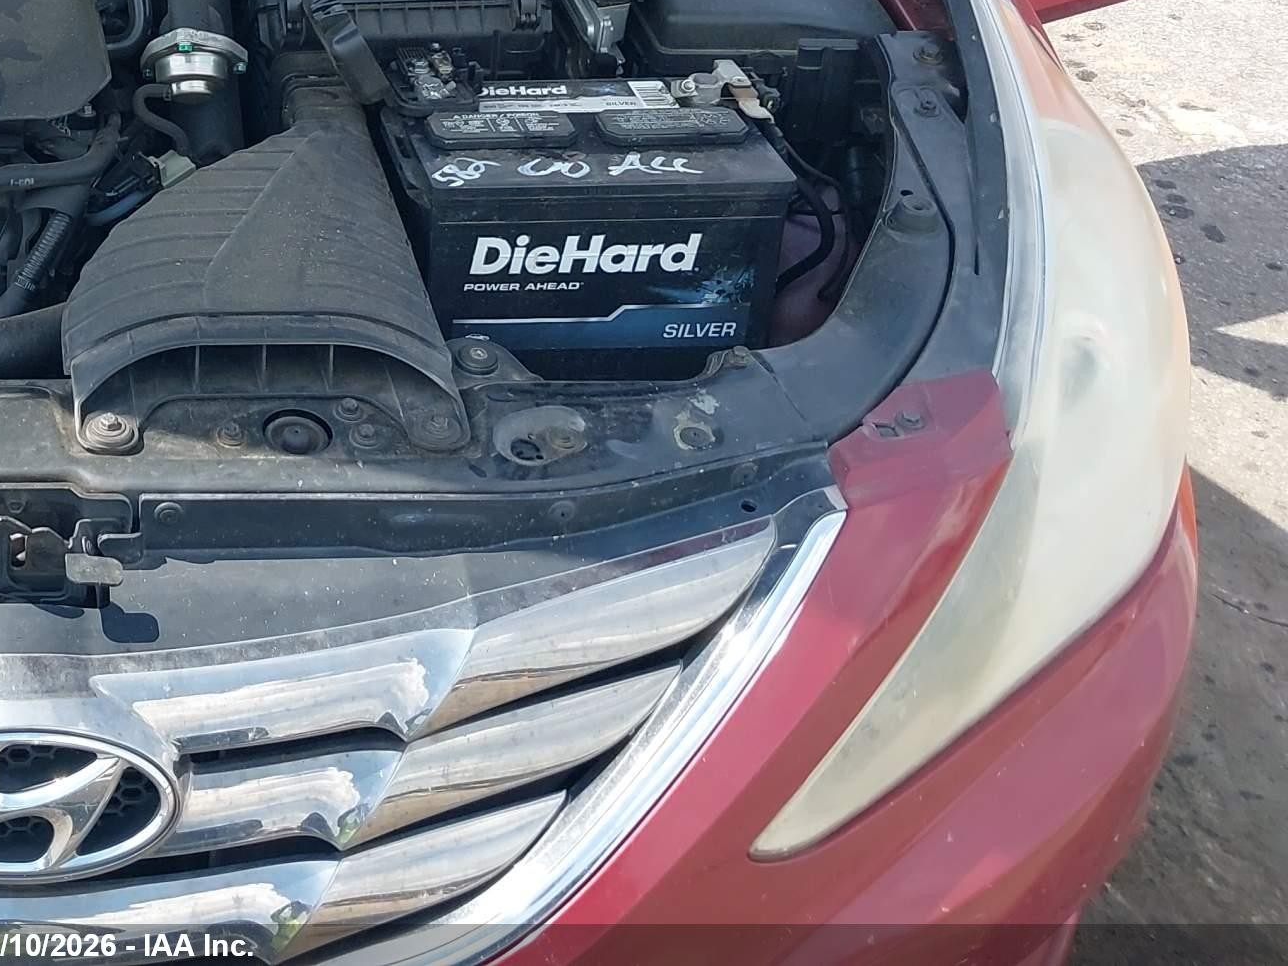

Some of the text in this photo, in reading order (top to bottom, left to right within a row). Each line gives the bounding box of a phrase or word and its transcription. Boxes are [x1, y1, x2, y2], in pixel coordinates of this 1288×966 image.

[469, 233, 703, 275] DieHard
[463, 281, 581, 292] POWER AHEAD
[662, 322, 737, 339] SILVER
